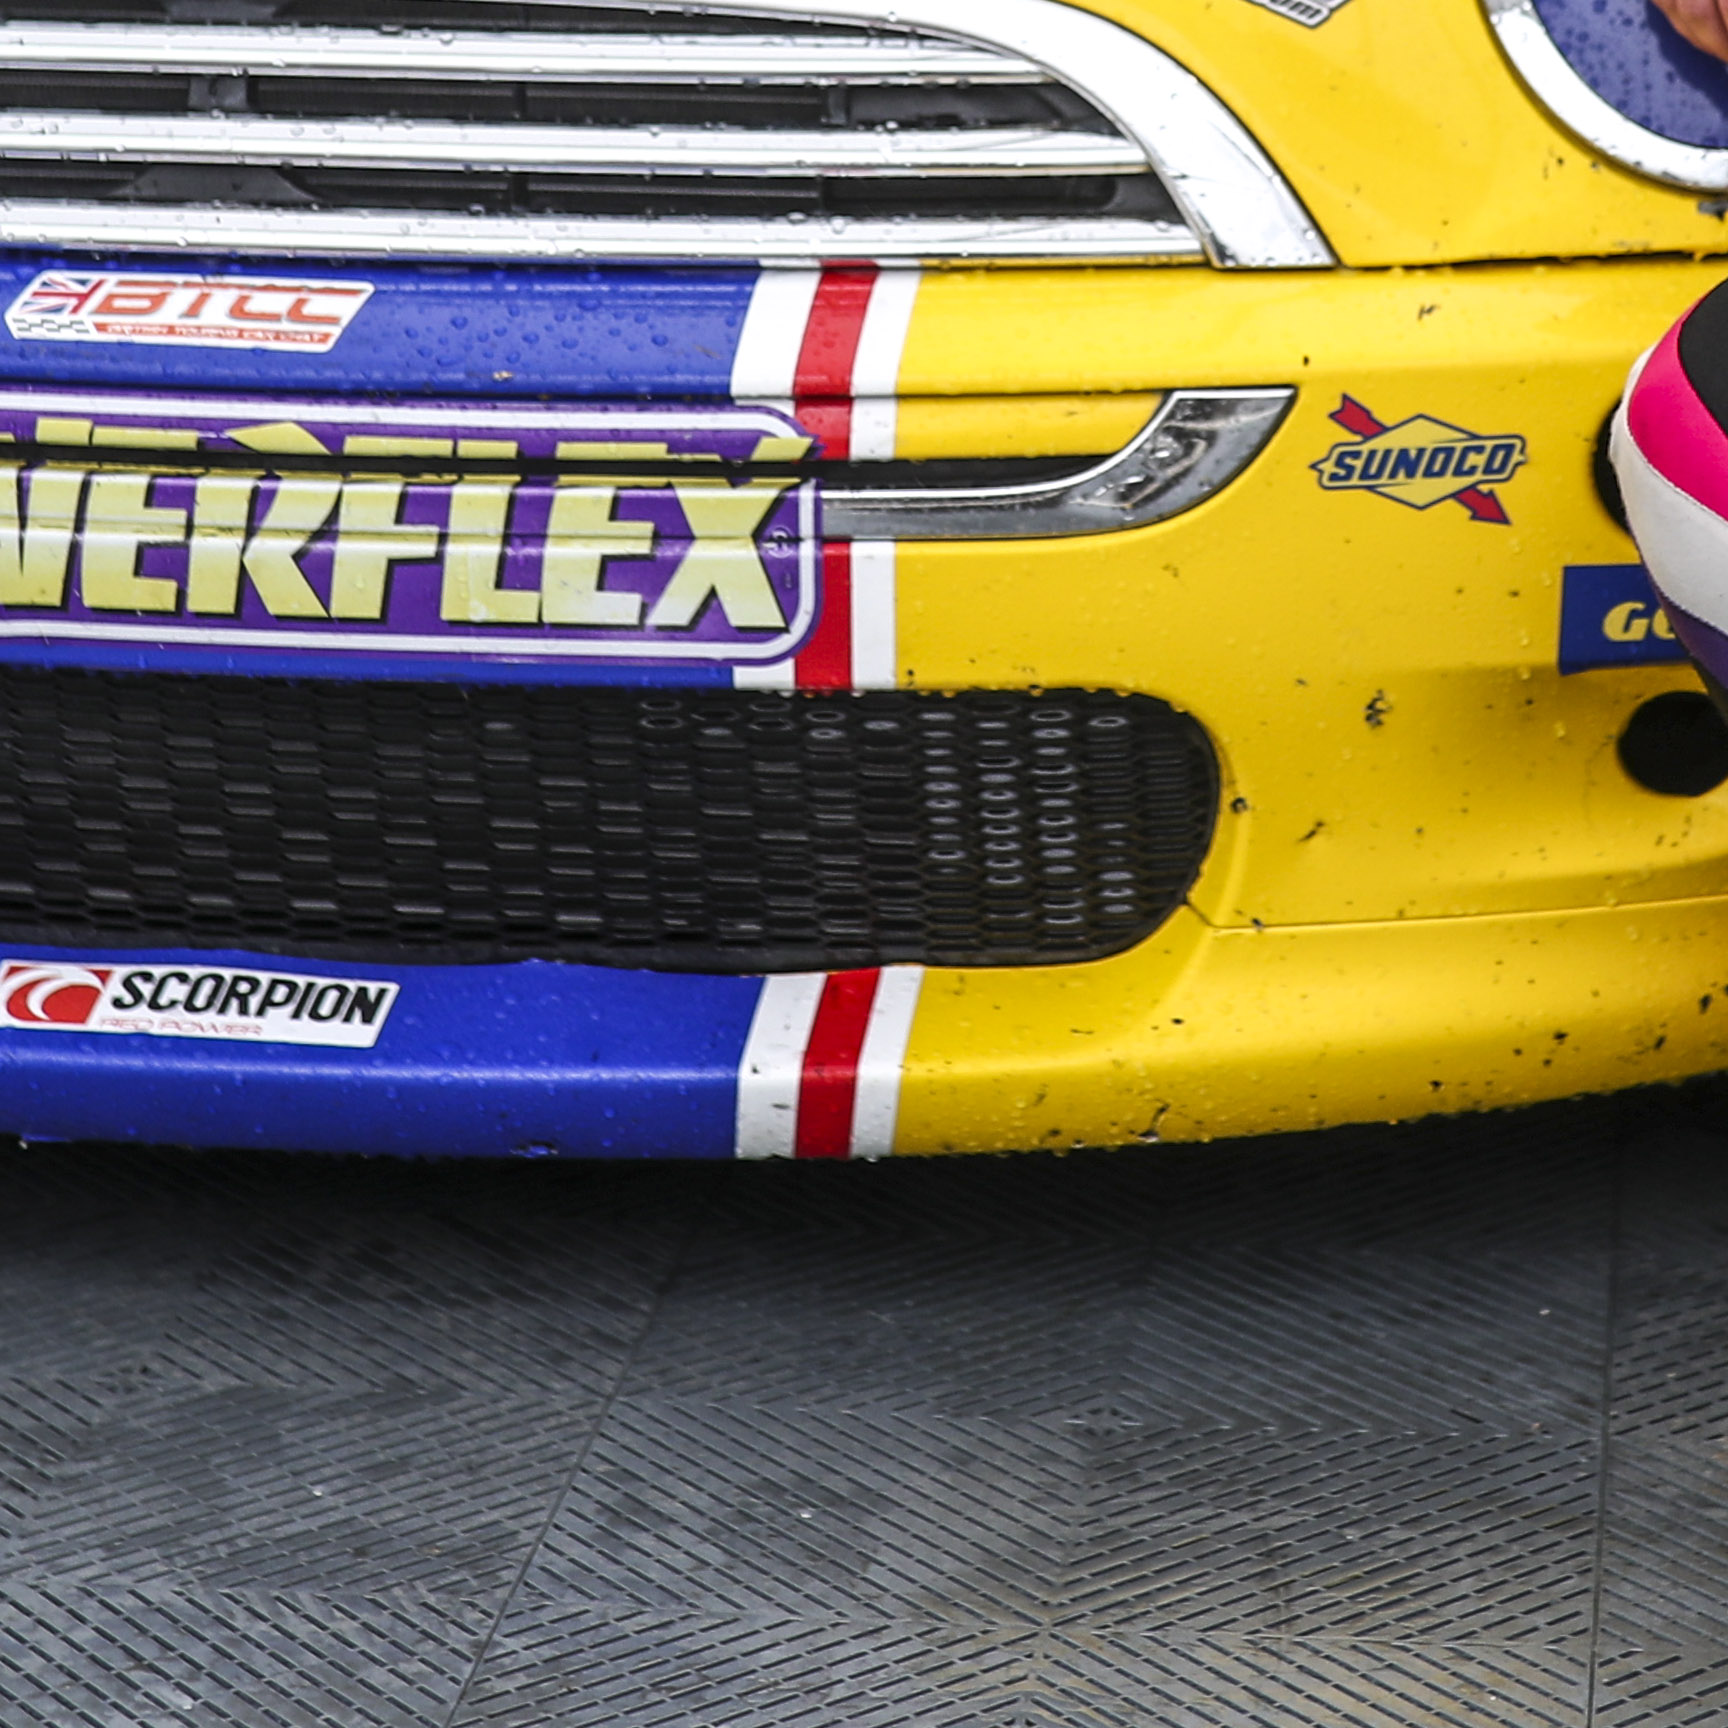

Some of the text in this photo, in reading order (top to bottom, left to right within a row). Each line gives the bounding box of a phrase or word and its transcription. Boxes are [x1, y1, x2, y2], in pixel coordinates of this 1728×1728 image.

[94, 280, 364, 324] BTCC
[1328, 443, 1516, 482] SUNOCO
[111, 971, 390, 1025] SCORPION
[159, 1020, 263, 1037] POWER
